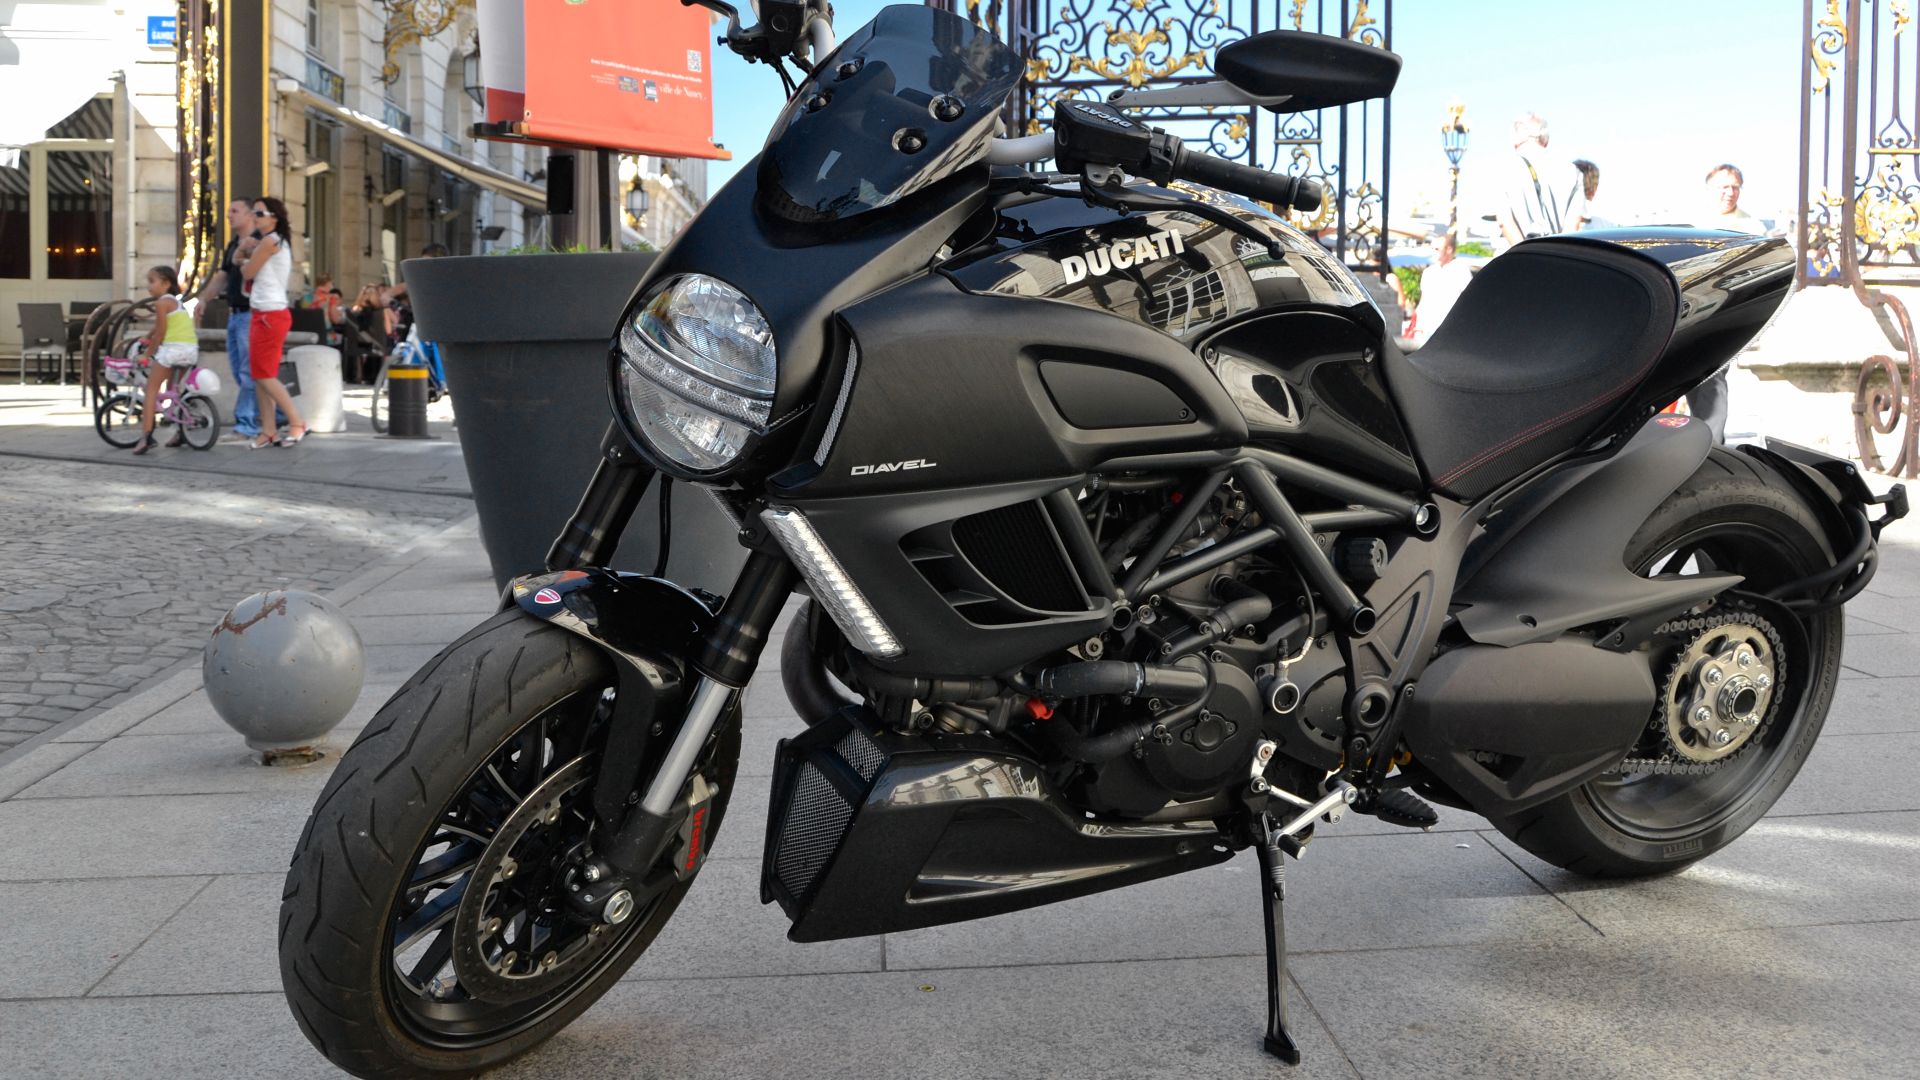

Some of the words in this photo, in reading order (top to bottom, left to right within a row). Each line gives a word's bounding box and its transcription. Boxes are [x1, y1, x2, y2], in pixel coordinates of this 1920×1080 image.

[1073, 104, 1134, 128] DUCATI
[1060, 228, 1185, 285] DUCATI
[850, 458, 937, 476] DIAVEL
[685, 807, 706, 869] brembo
